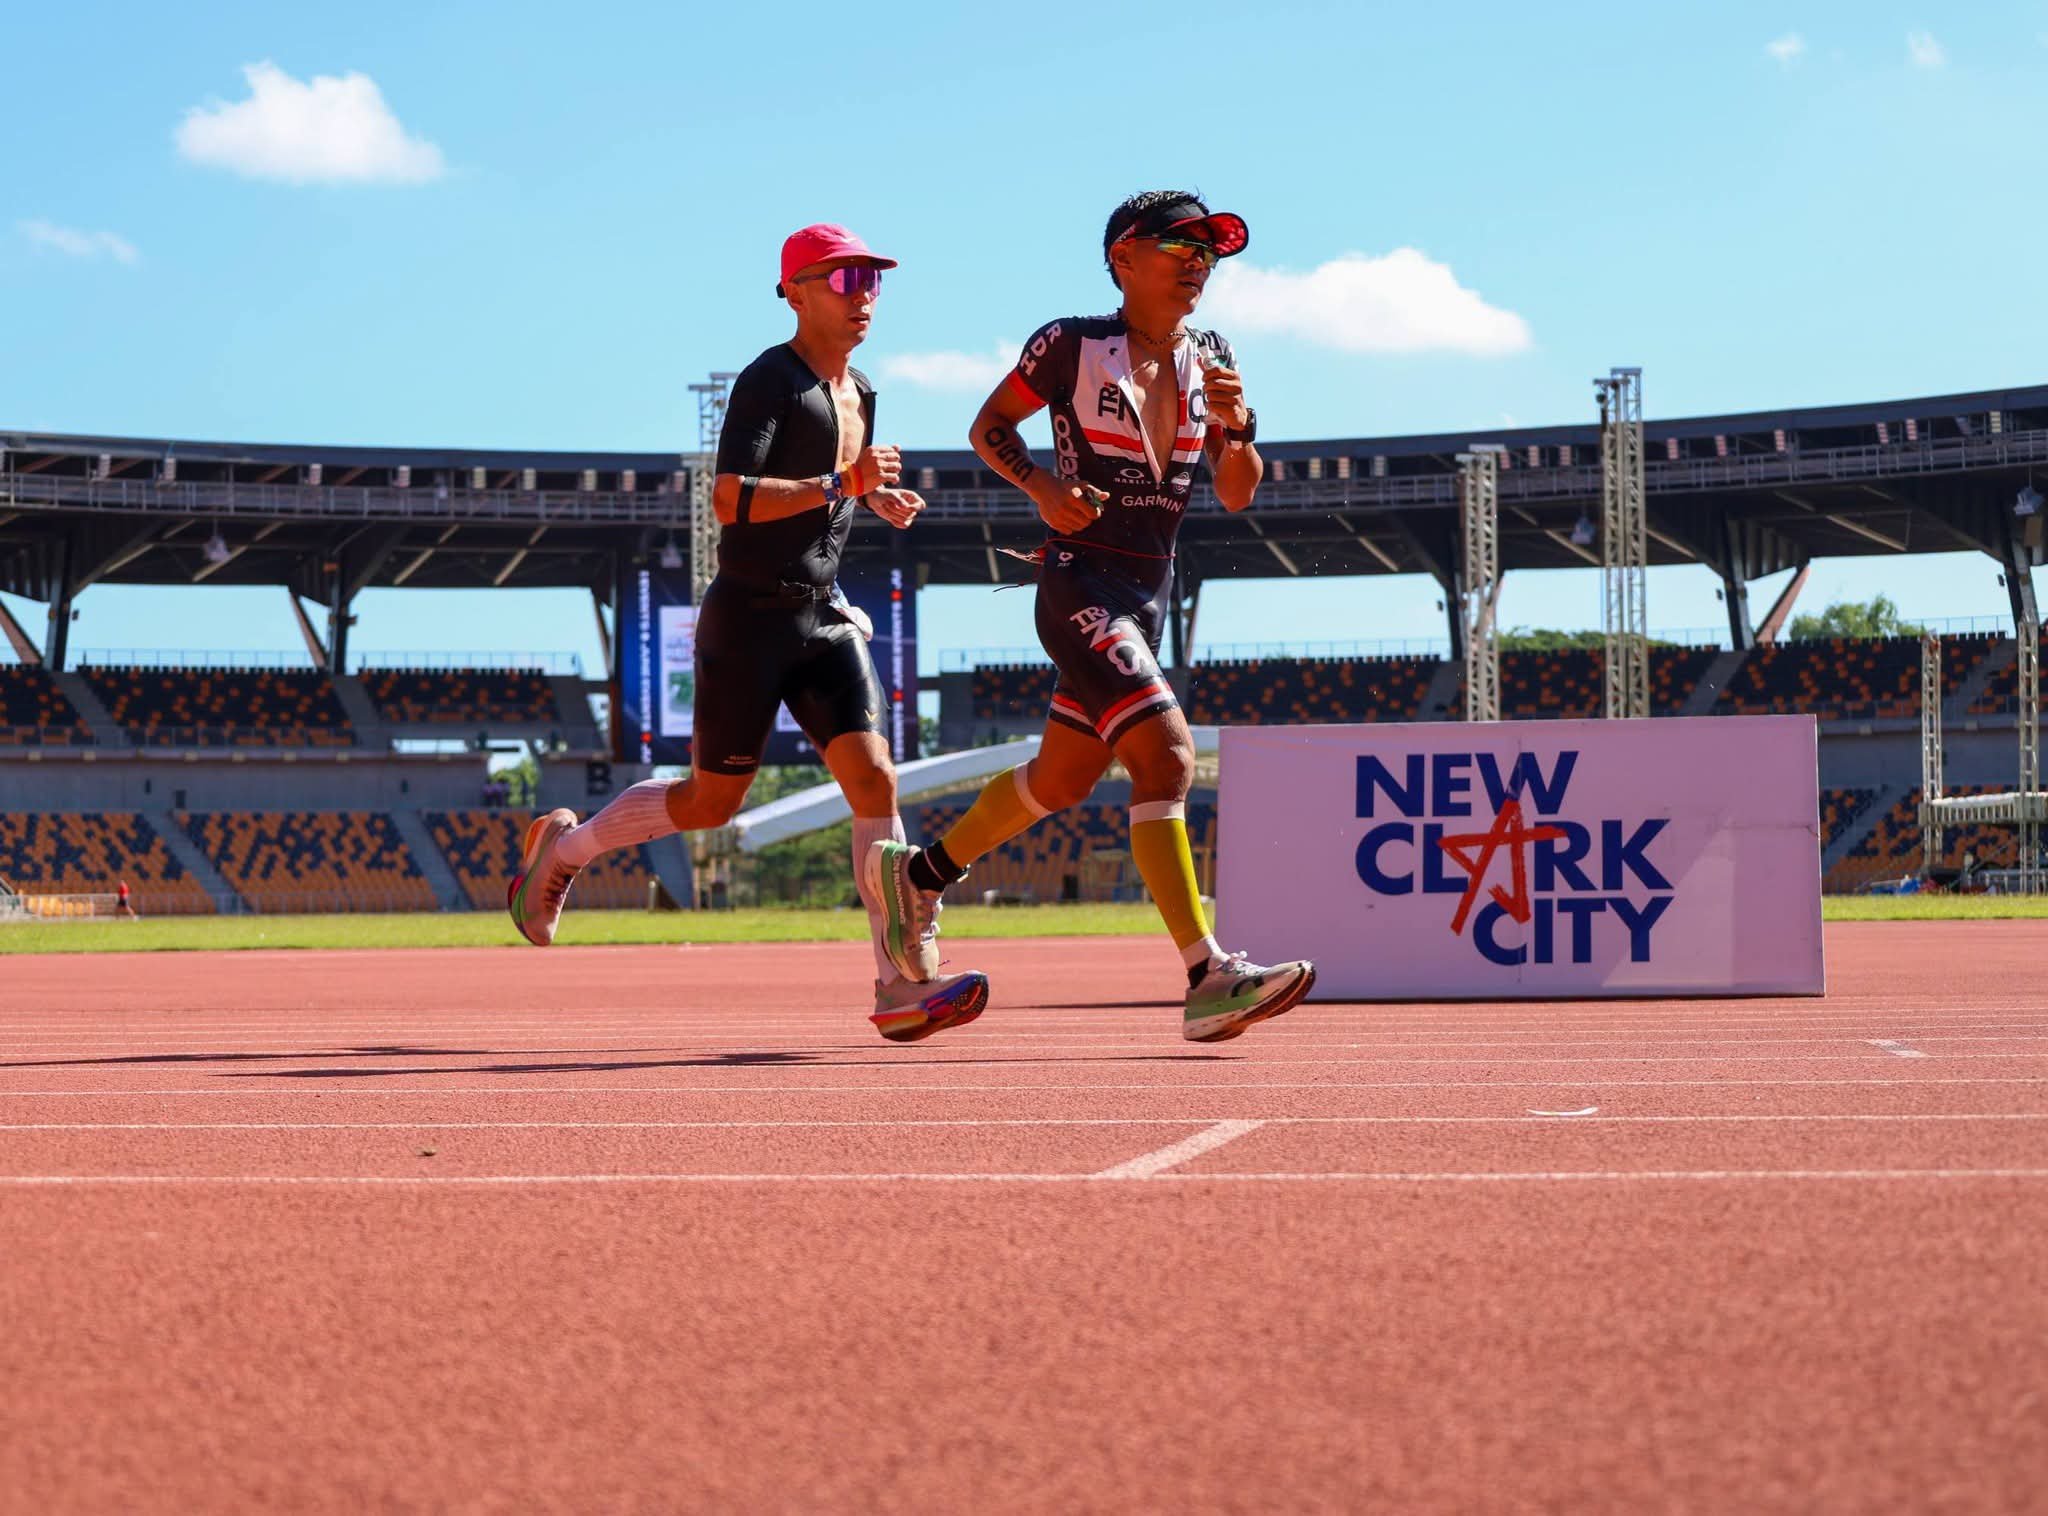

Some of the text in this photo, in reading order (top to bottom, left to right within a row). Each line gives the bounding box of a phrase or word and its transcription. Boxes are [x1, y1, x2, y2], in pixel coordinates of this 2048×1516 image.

[1121, 494, 1183, 513] GARMIN
[1355, 750, 1579, 818] NEW
[1355, 807, 1674, 923] CLARK
[1472, 895, 1675, 965] CITY
